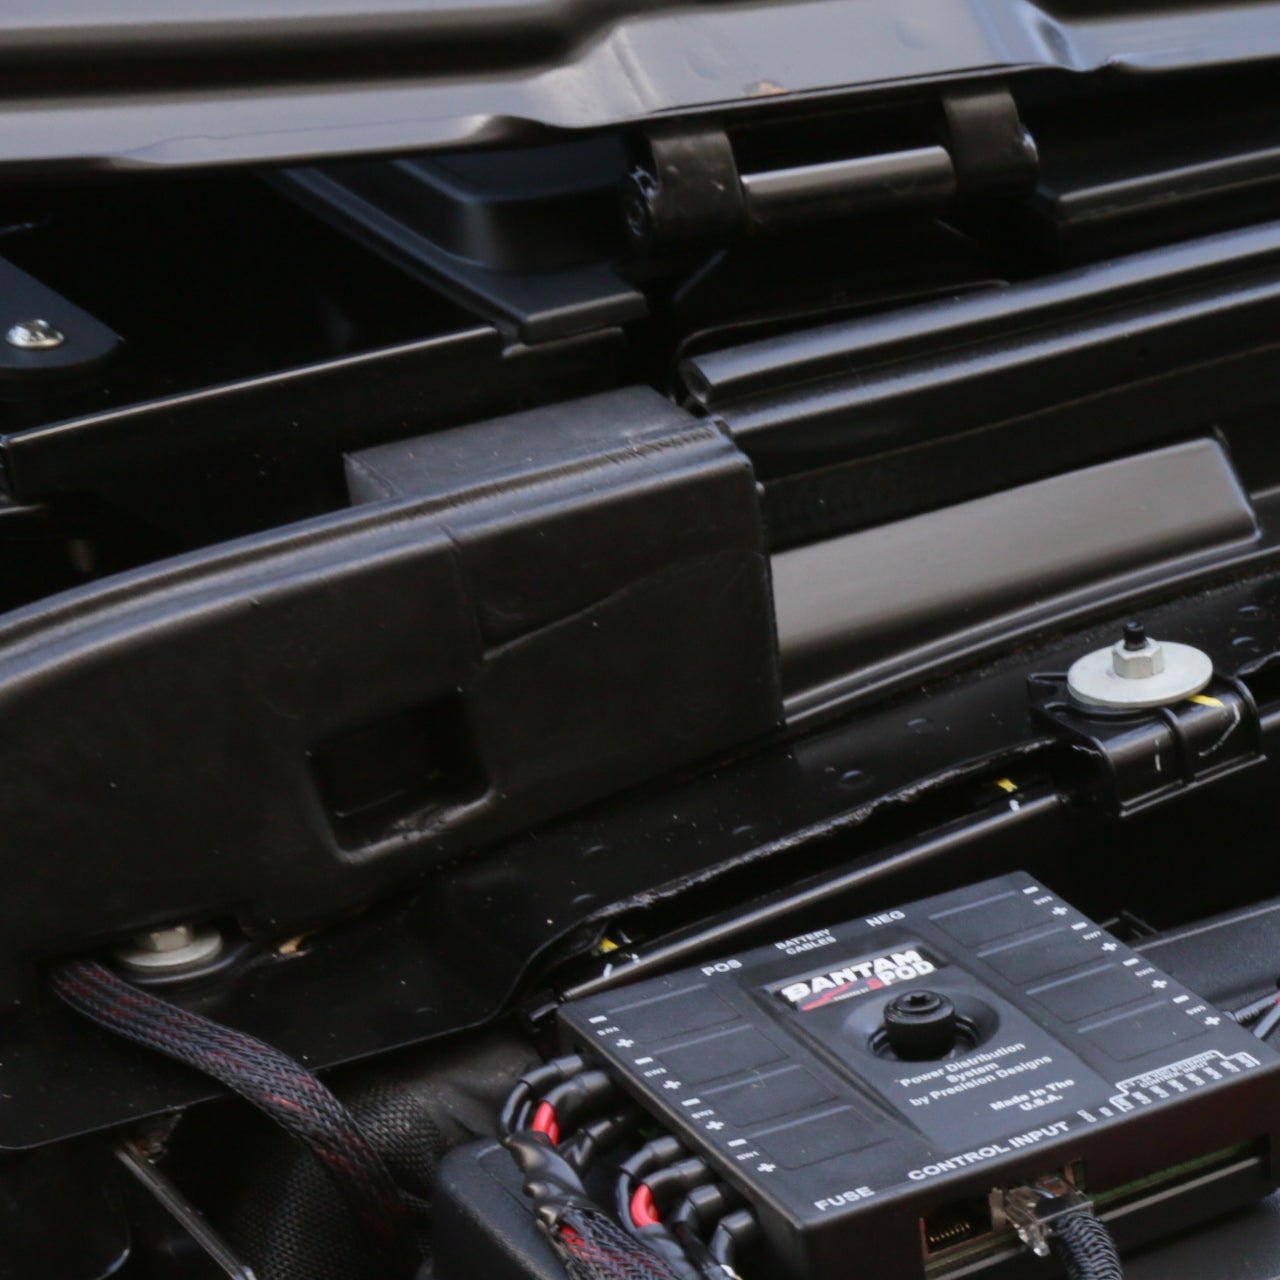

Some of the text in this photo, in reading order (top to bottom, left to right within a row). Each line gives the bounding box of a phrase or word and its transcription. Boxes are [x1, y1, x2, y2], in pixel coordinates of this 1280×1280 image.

[865, 910, 906, 927] NEG
[775, 929, 830, 950] BATTERY
[785, 936, 837, 955] CABLES
[701, 959, 743, 976] POS
[781, 950, 924, 1002] BANTAM
[899, 1042, 1026, 1087] Power Distribution
[945, 1062, 999, 1084] System
[909, 1055, 1053, 1106] by Precision Designs
[990, 1091, 1030, 1111] Made
[1045, 1079, 1075, 1093] The
[1019, 1094, 1064, 1111] U.S.A.
[908, 1121, 1070, 1181] CONTROL INPUT
[813, 1185, 876, 1213] FUSE
